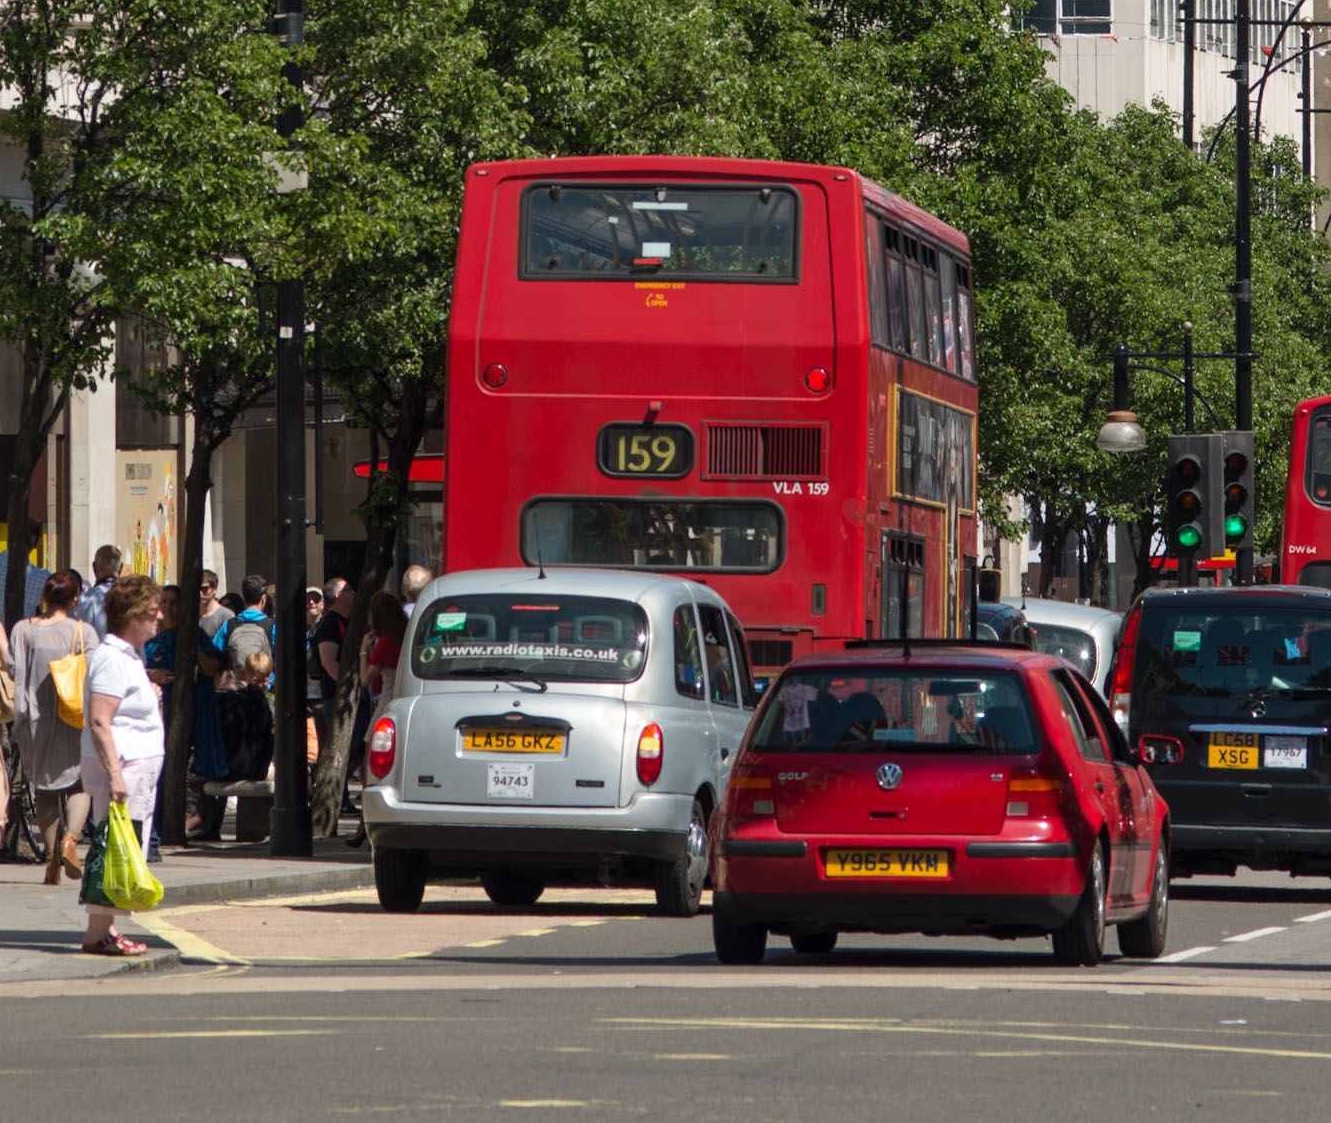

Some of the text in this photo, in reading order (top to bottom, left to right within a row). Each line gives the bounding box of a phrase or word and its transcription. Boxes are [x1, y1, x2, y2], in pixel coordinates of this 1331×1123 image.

[619, 435, 676, 472] 159
[773, 482, 830, 496] VLA 159
[1288, 545, 1317, 555] DW 64
[441, 644, 619, 661] www.radiotaxis.co.uk
[471, 732, 556, 750] LA56 GKZ
[1213, 732, 1254, 765] LC58 XSG
[1270, 746, 1303, 758] 17967
[493, 776, 529, 788] 94743
[778, 772, 809, 781] GOLF
[837, 853, 939, 873] Y965 VKM
